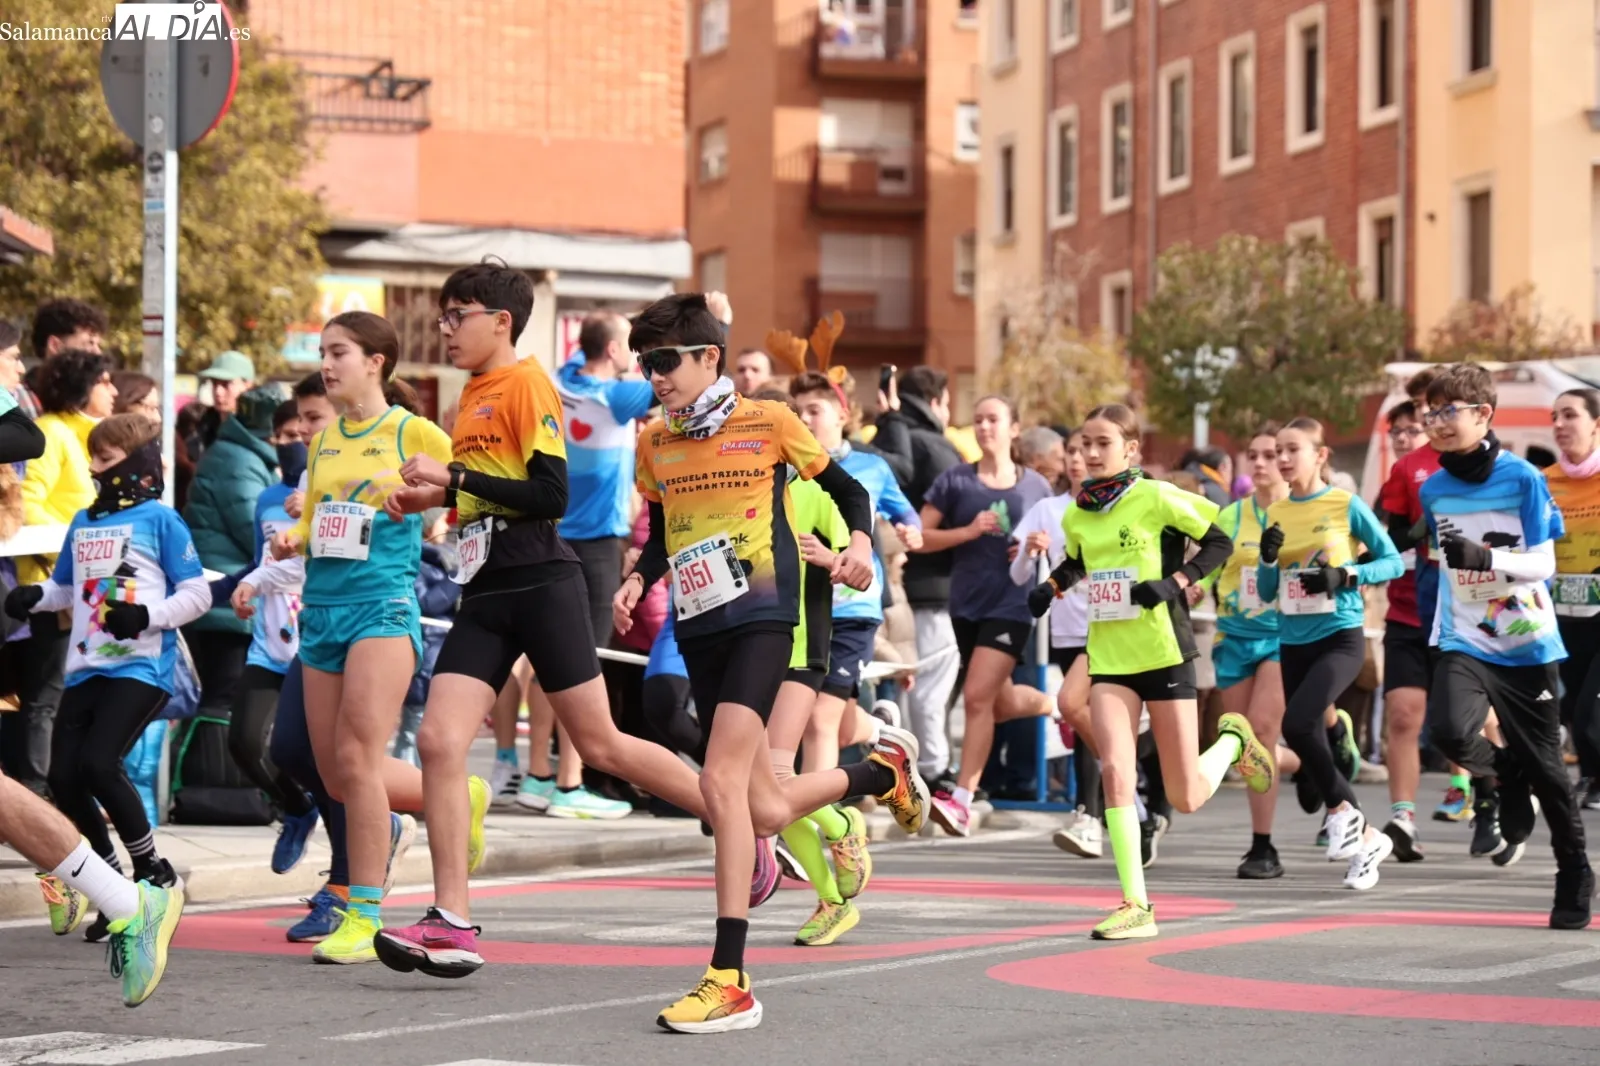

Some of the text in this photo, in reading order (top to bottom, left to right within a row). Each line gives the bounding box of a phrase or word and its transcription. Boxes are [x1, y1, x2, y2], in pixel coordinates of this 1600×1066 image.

[666, 472, 709, 486] ESCUELA
[674, 480, 750, 494] SALMANTINA
[324, 504, 366, 516] SETEL
[85, 528, 125, 539] SETEL
[318, 516, 348, 538] 6191
[77, 539, 115, 563] 6220
[678, 559, 714, 596] 6151
[1092, 571, 1131, 580] SETEL
